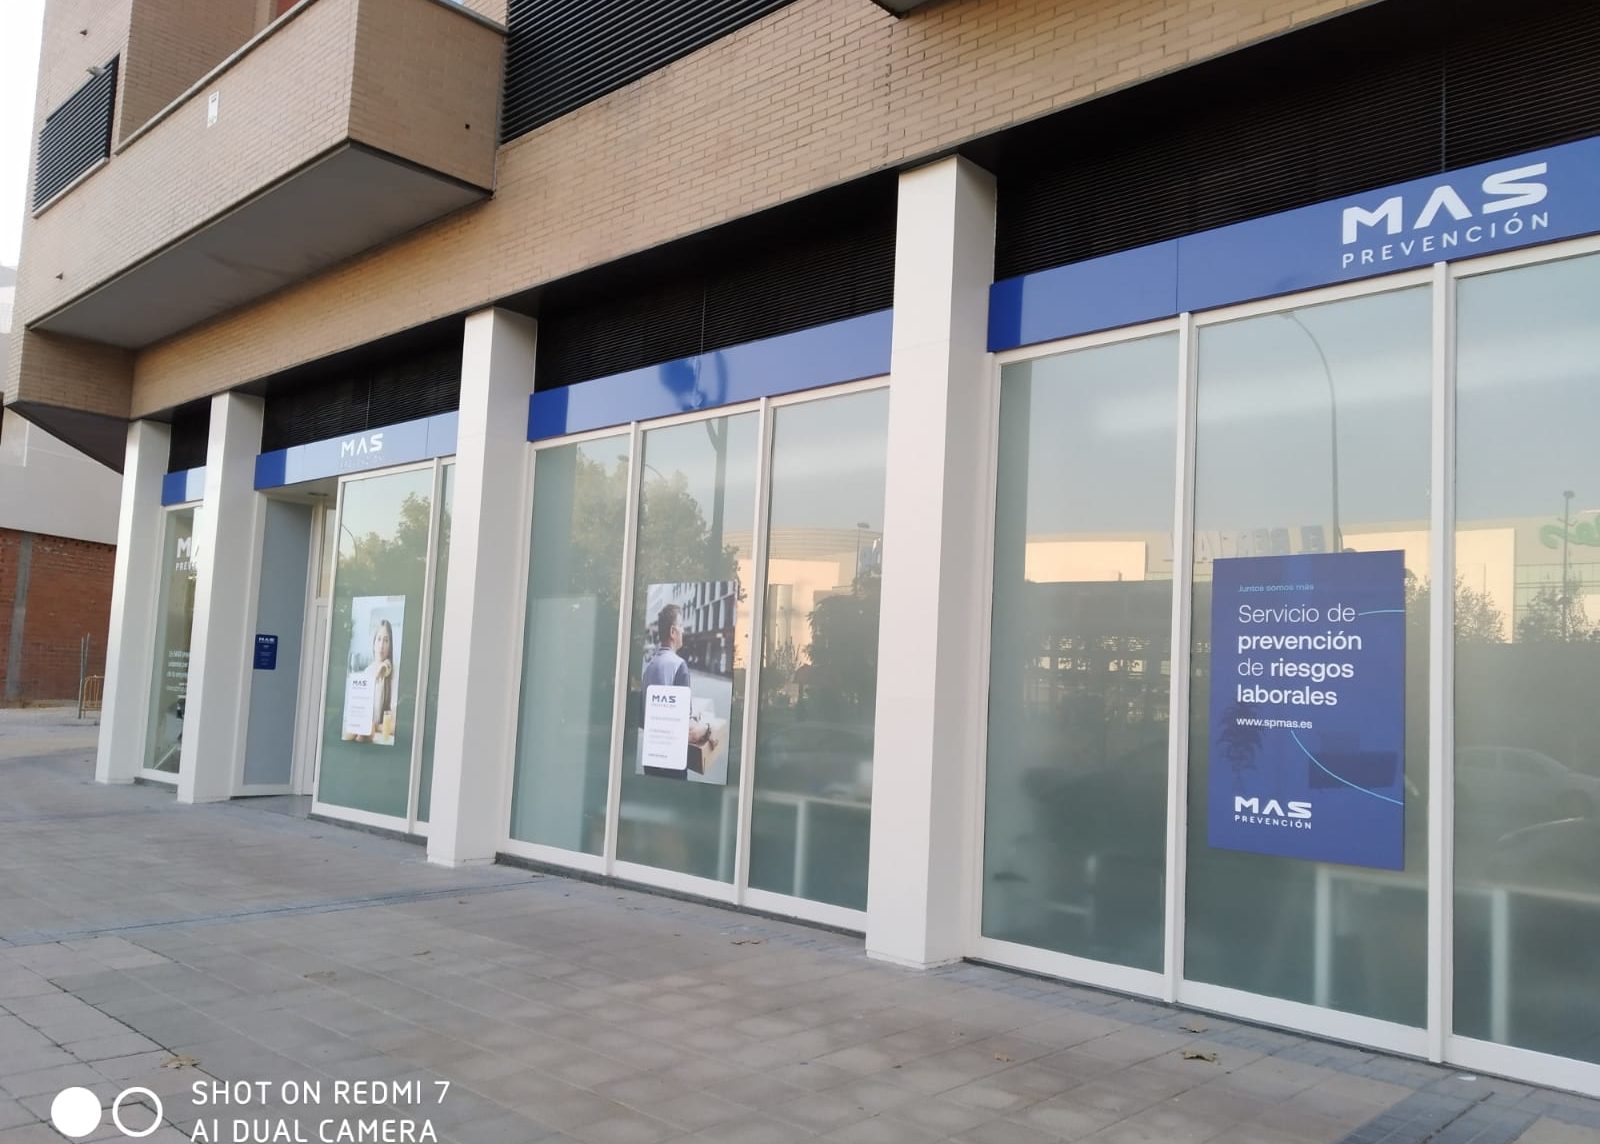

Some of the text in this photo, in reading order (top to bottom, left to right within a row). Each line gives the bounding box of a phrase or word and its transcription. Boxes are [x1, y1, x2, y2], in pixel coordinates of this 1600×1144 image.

[1342, 162, 1548, 245] MAS
[1342, 212, 1549, 269] PREVENCIÓN
[341, 433, 384, 458] MAS
[1238, 603, 1356, 624] Servicio de
[1238, 630, 1362, 654] prevención
[1238, 657, 1354, 683] de riesgos
[652, 694, 676, 704] MAS
[1237, 684, 1338, 706] laborales
[1236, 717, 1313, 730] www.spmas.es
[1235, 796, 1312, 819] MAS
[1235, 814, 1312, 830] PREVENCIÓN
